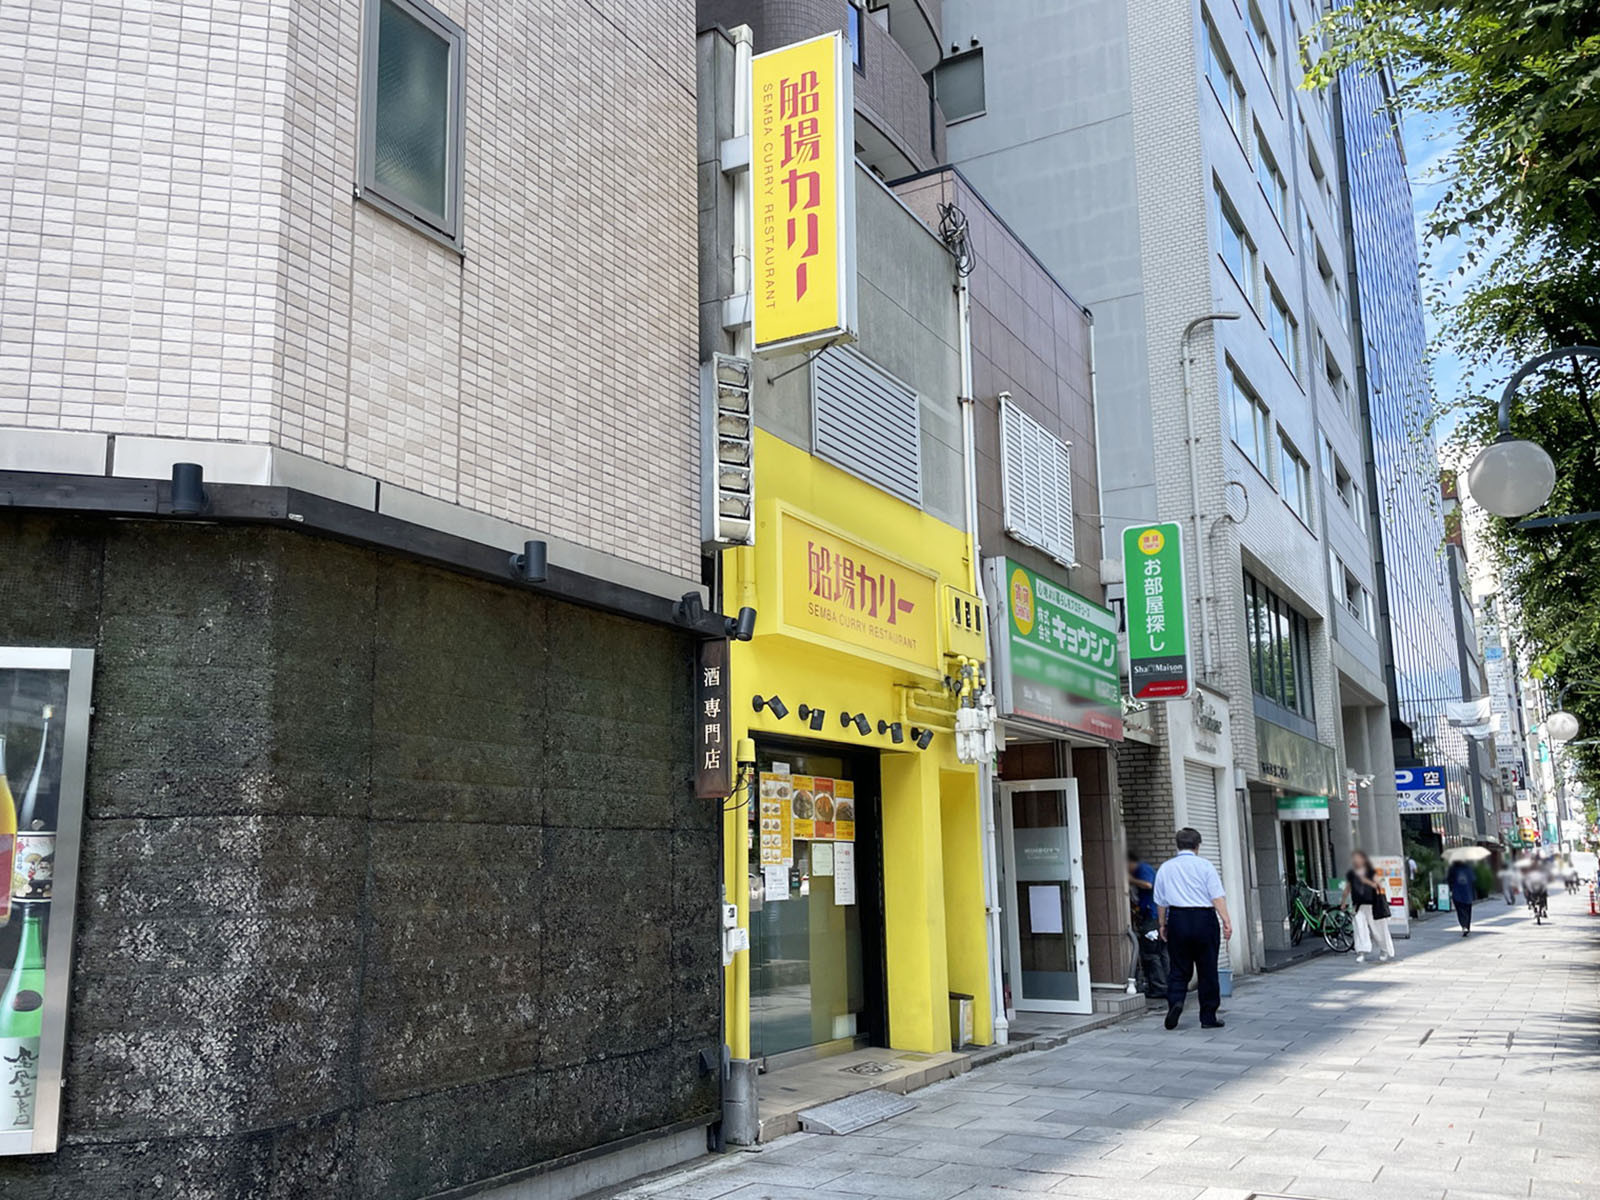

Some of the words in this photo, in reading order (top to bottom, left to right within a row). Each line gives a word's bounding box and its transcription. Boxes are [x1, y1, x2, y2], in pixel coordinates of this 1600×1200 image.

[762, 83, 773, 137] SEMBA
[763, 143, 774, 197] CURRY
[779, 71, 821, 303] 船場カリー
[764, 204, 776, 310] RESTAURANT
[808, 541, 915, 625] 船場カリー
[1144, 559, 1165, 652] お部屋探し
[808, 602, 836, 624] SEMBA
[839, 614, 867, 635] CURRY
[869, 623, 917, 650] RESTAURANT
[704, 666, 721, 770] 酒専門店
[1424, 771, 1440, 786] 空
